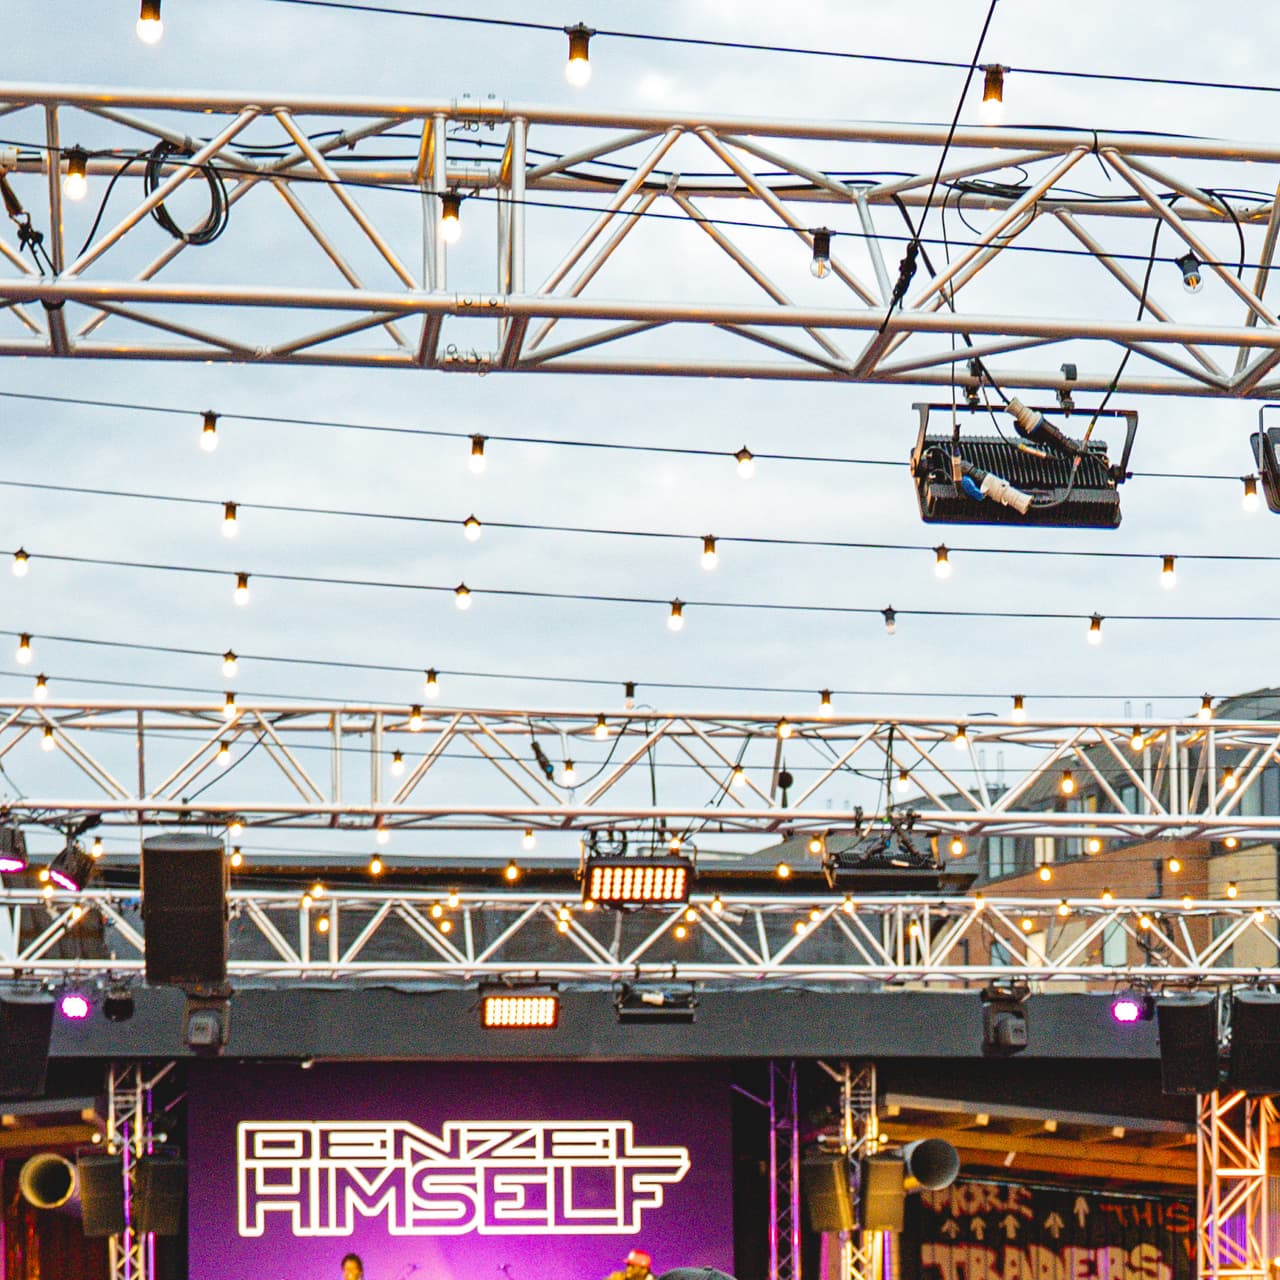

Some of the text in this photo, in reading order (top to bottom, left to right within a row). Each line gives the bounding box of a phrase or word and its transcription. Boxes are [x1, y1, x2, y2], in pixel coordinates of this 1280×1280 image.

[237, 1120, 689, 1167] DENZEL
[237, 1160, 691, 1237] HIMSELF
[1099, 1201, 1197, 1234] THIS
